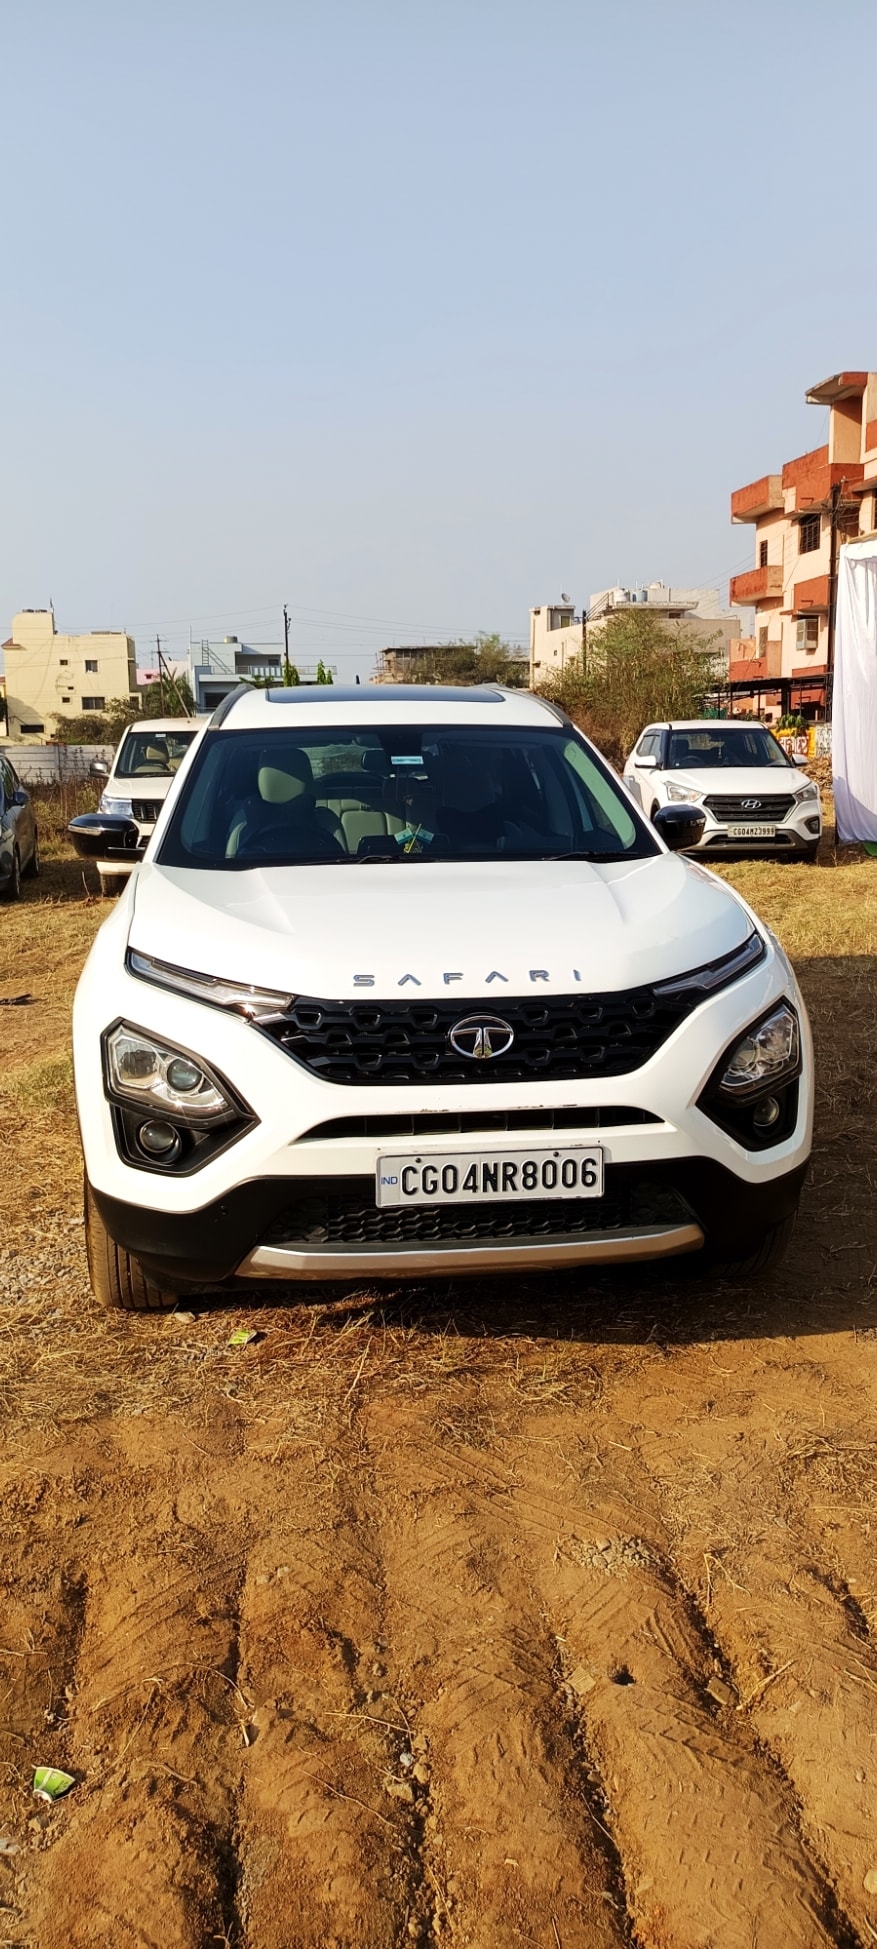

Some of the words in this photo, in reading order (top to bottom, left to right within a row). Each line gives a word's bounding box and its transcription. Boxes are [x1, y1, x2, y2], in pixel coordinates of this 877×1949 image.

[353, 969, 582, 987] SAFARI
[380, 1176, 399, 1185] IND
[401, 1157, 597, 1196] CG04NR8006
